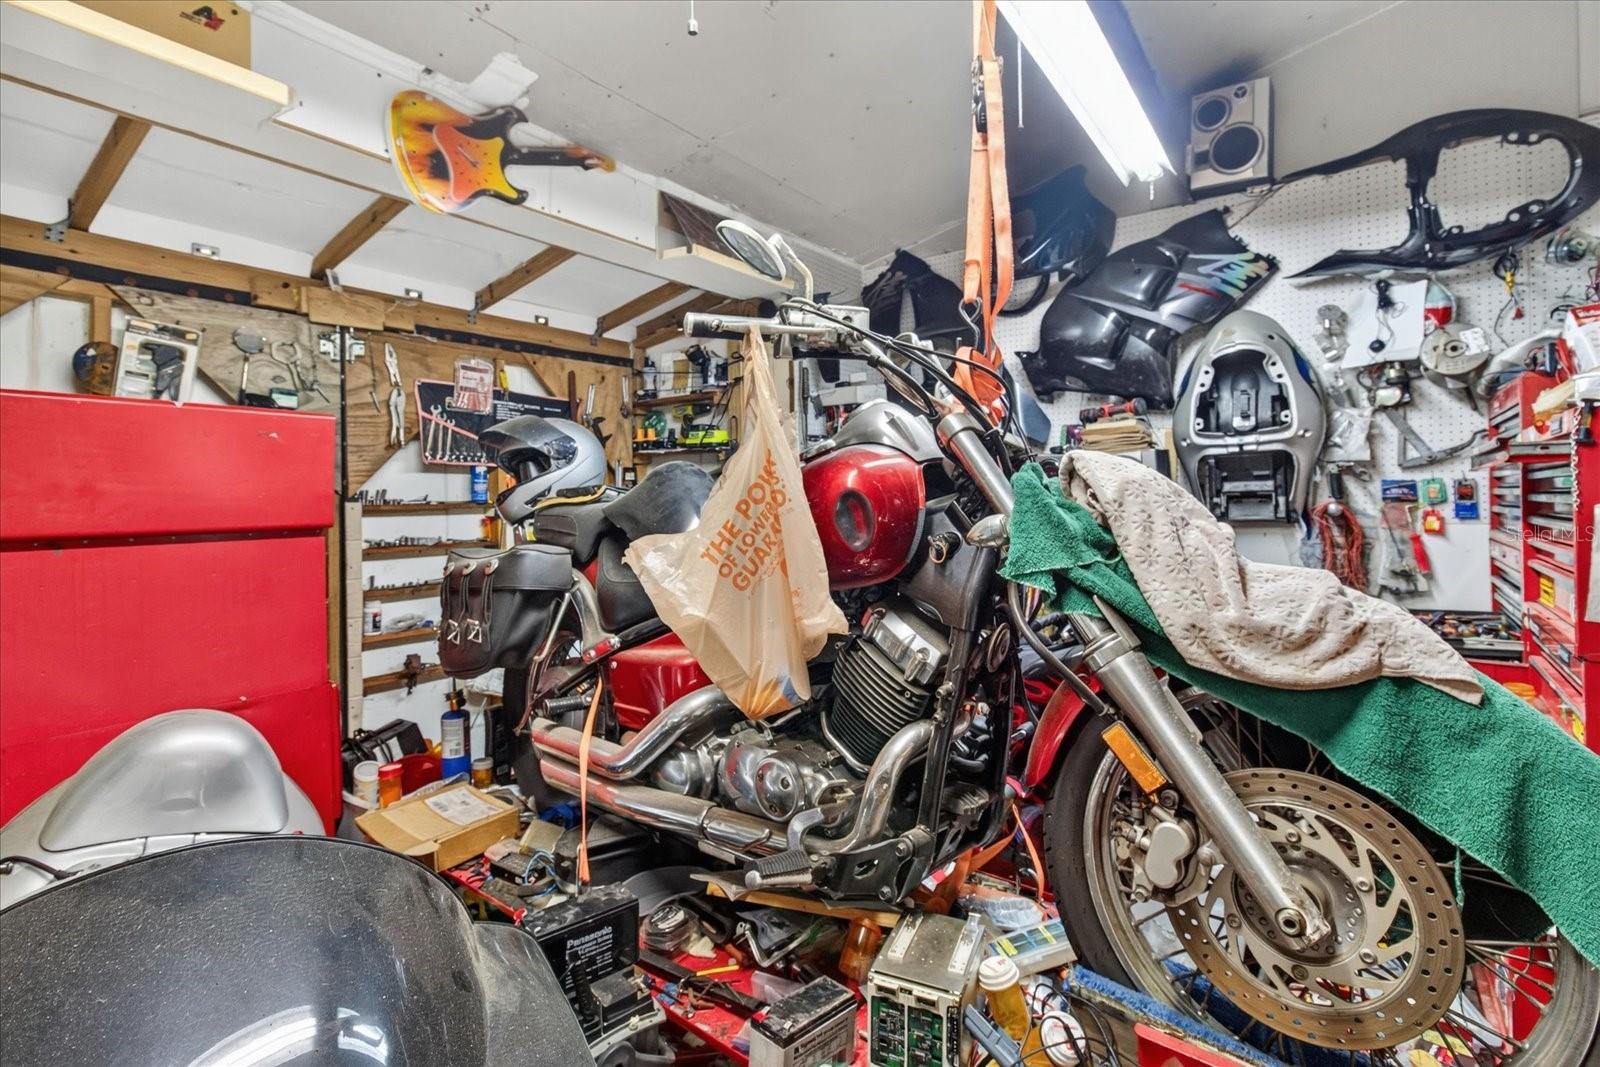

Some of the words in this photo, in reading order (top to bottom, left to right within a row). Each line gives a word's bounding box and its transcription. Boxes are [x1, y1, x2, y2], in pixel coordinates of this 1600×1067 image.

[701, 519, 743, 565] THE
[719, 554, 738, 578] OF
[566, 926, 613, 949] Panasonic
